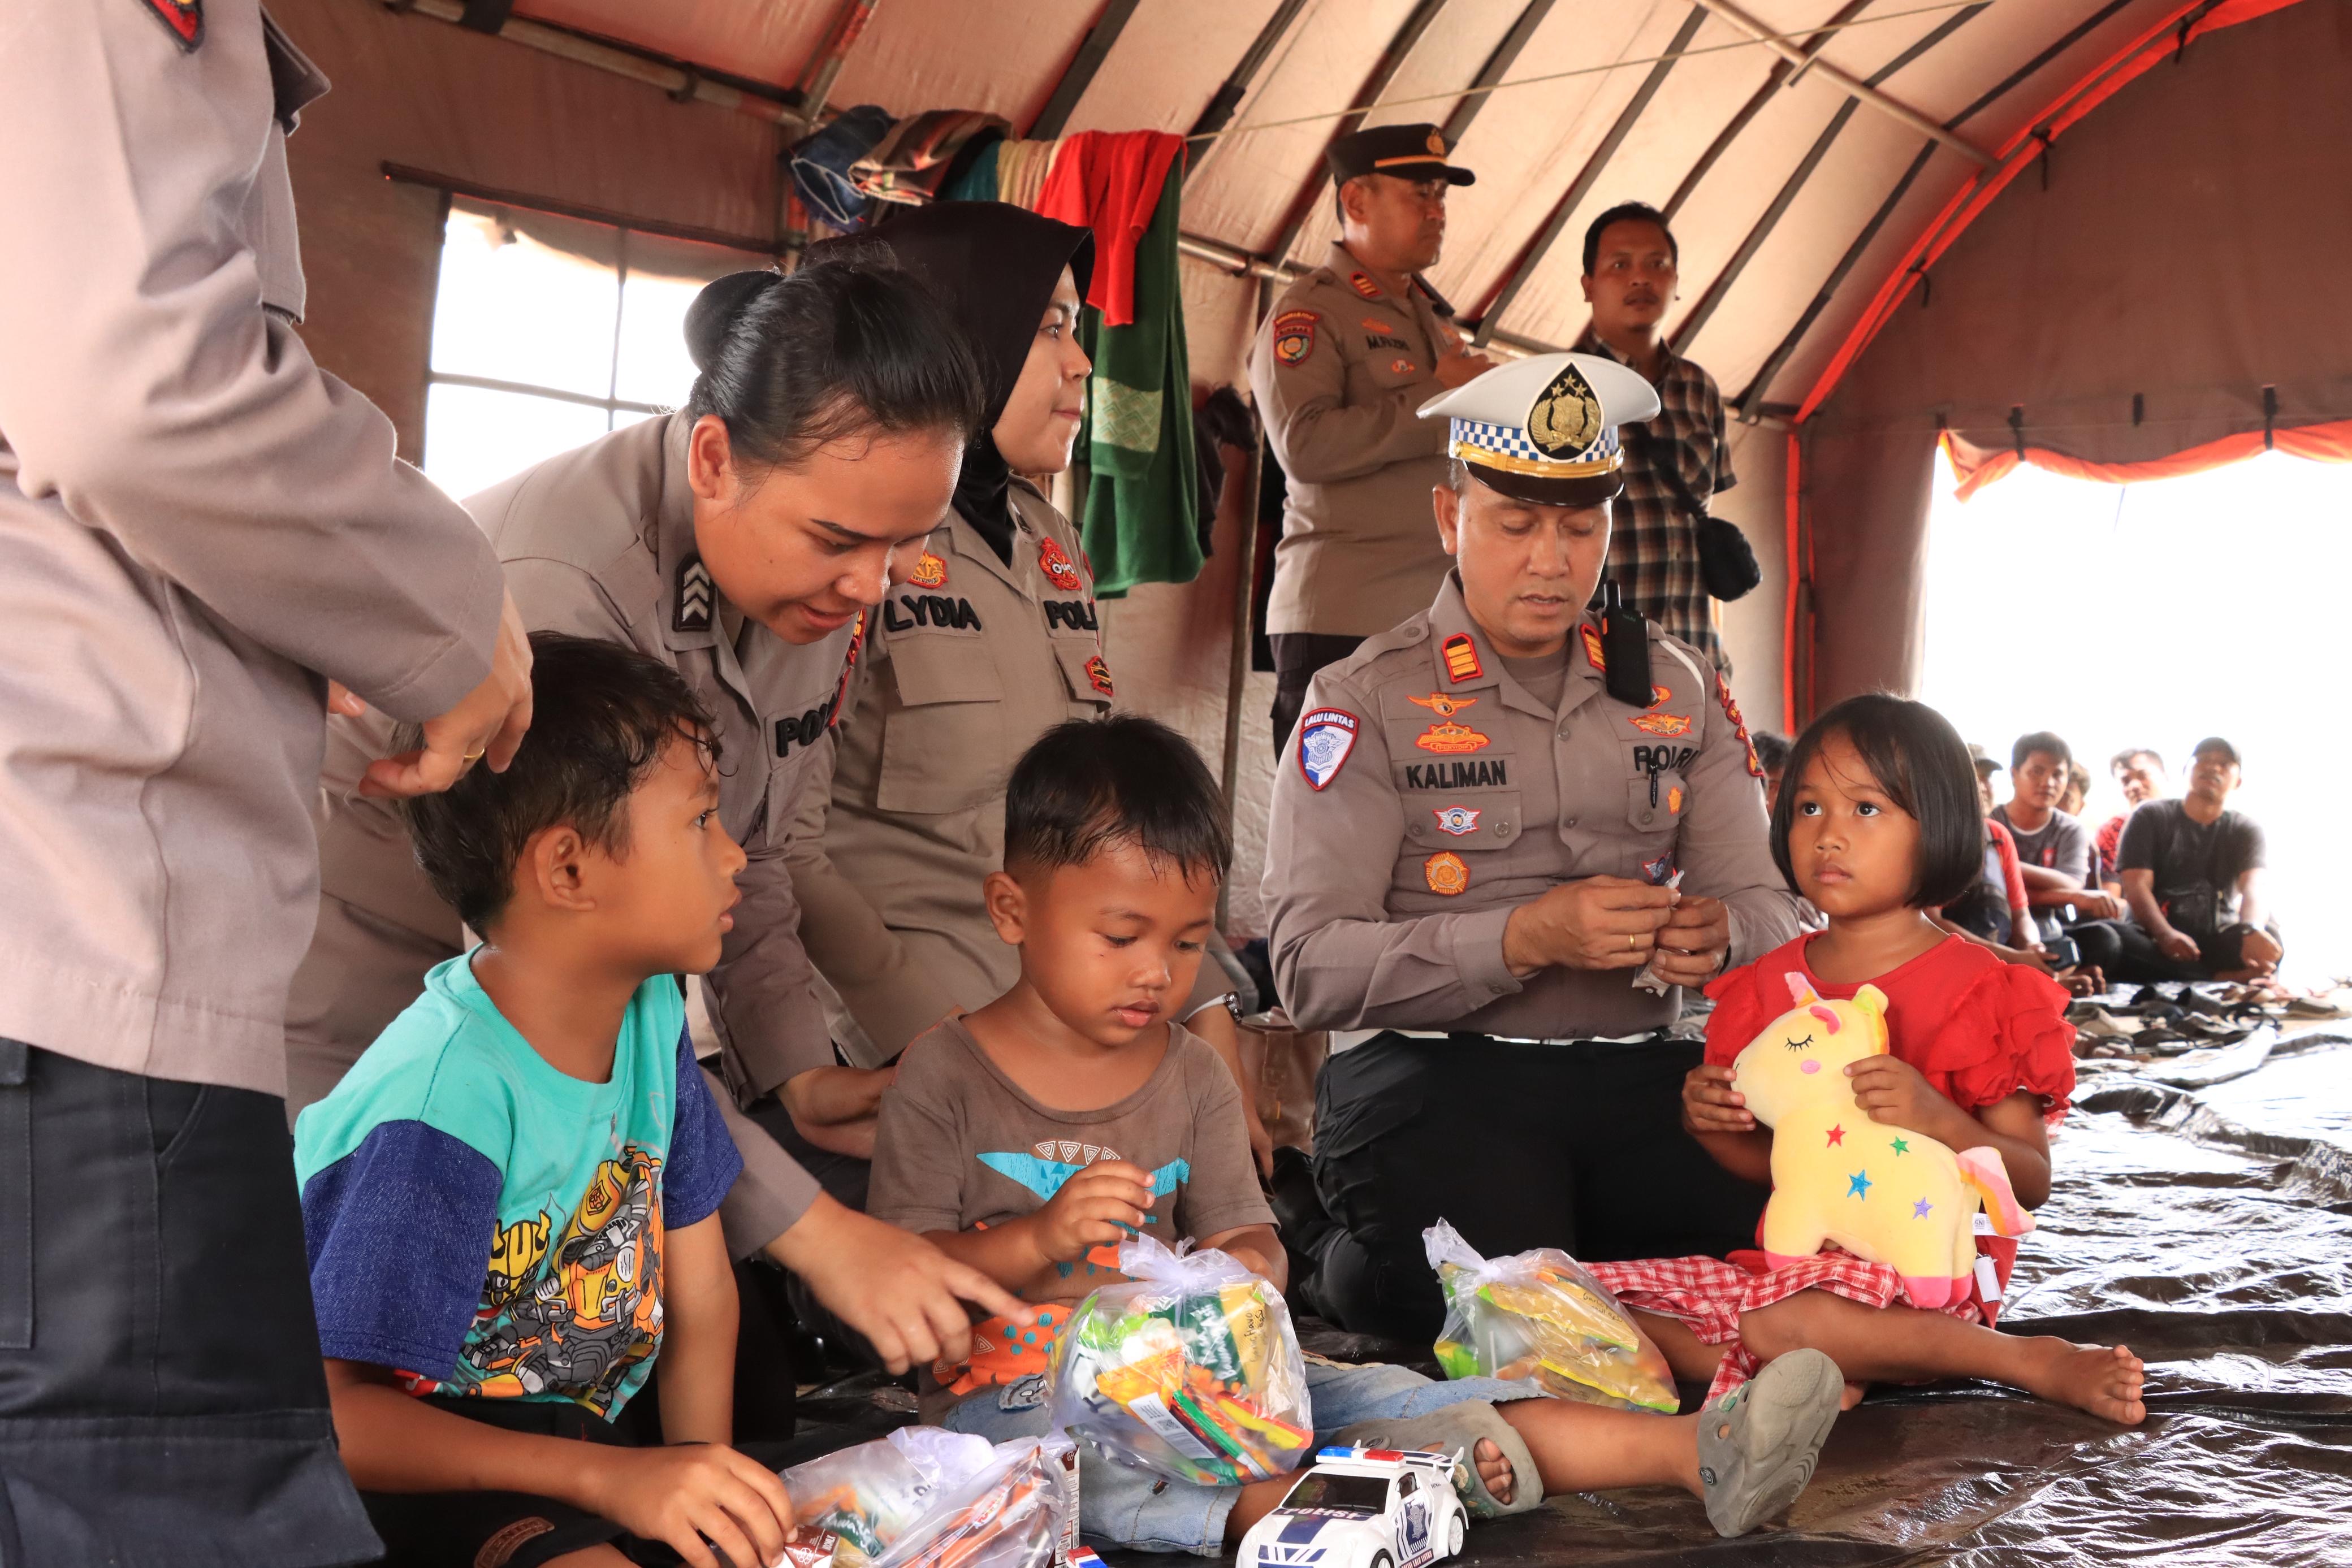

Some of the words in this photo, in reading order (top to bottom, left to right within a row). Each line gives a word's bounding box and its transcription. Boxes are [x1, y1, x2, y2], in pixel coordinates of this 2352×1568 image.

[884, 595, 982, 631] LYDIA
[1304, 713, 1324, 727] LALU
[1324, 713, 1355, 729] LINTAS
[1406, 760, 1507, 789] KALIMAN
